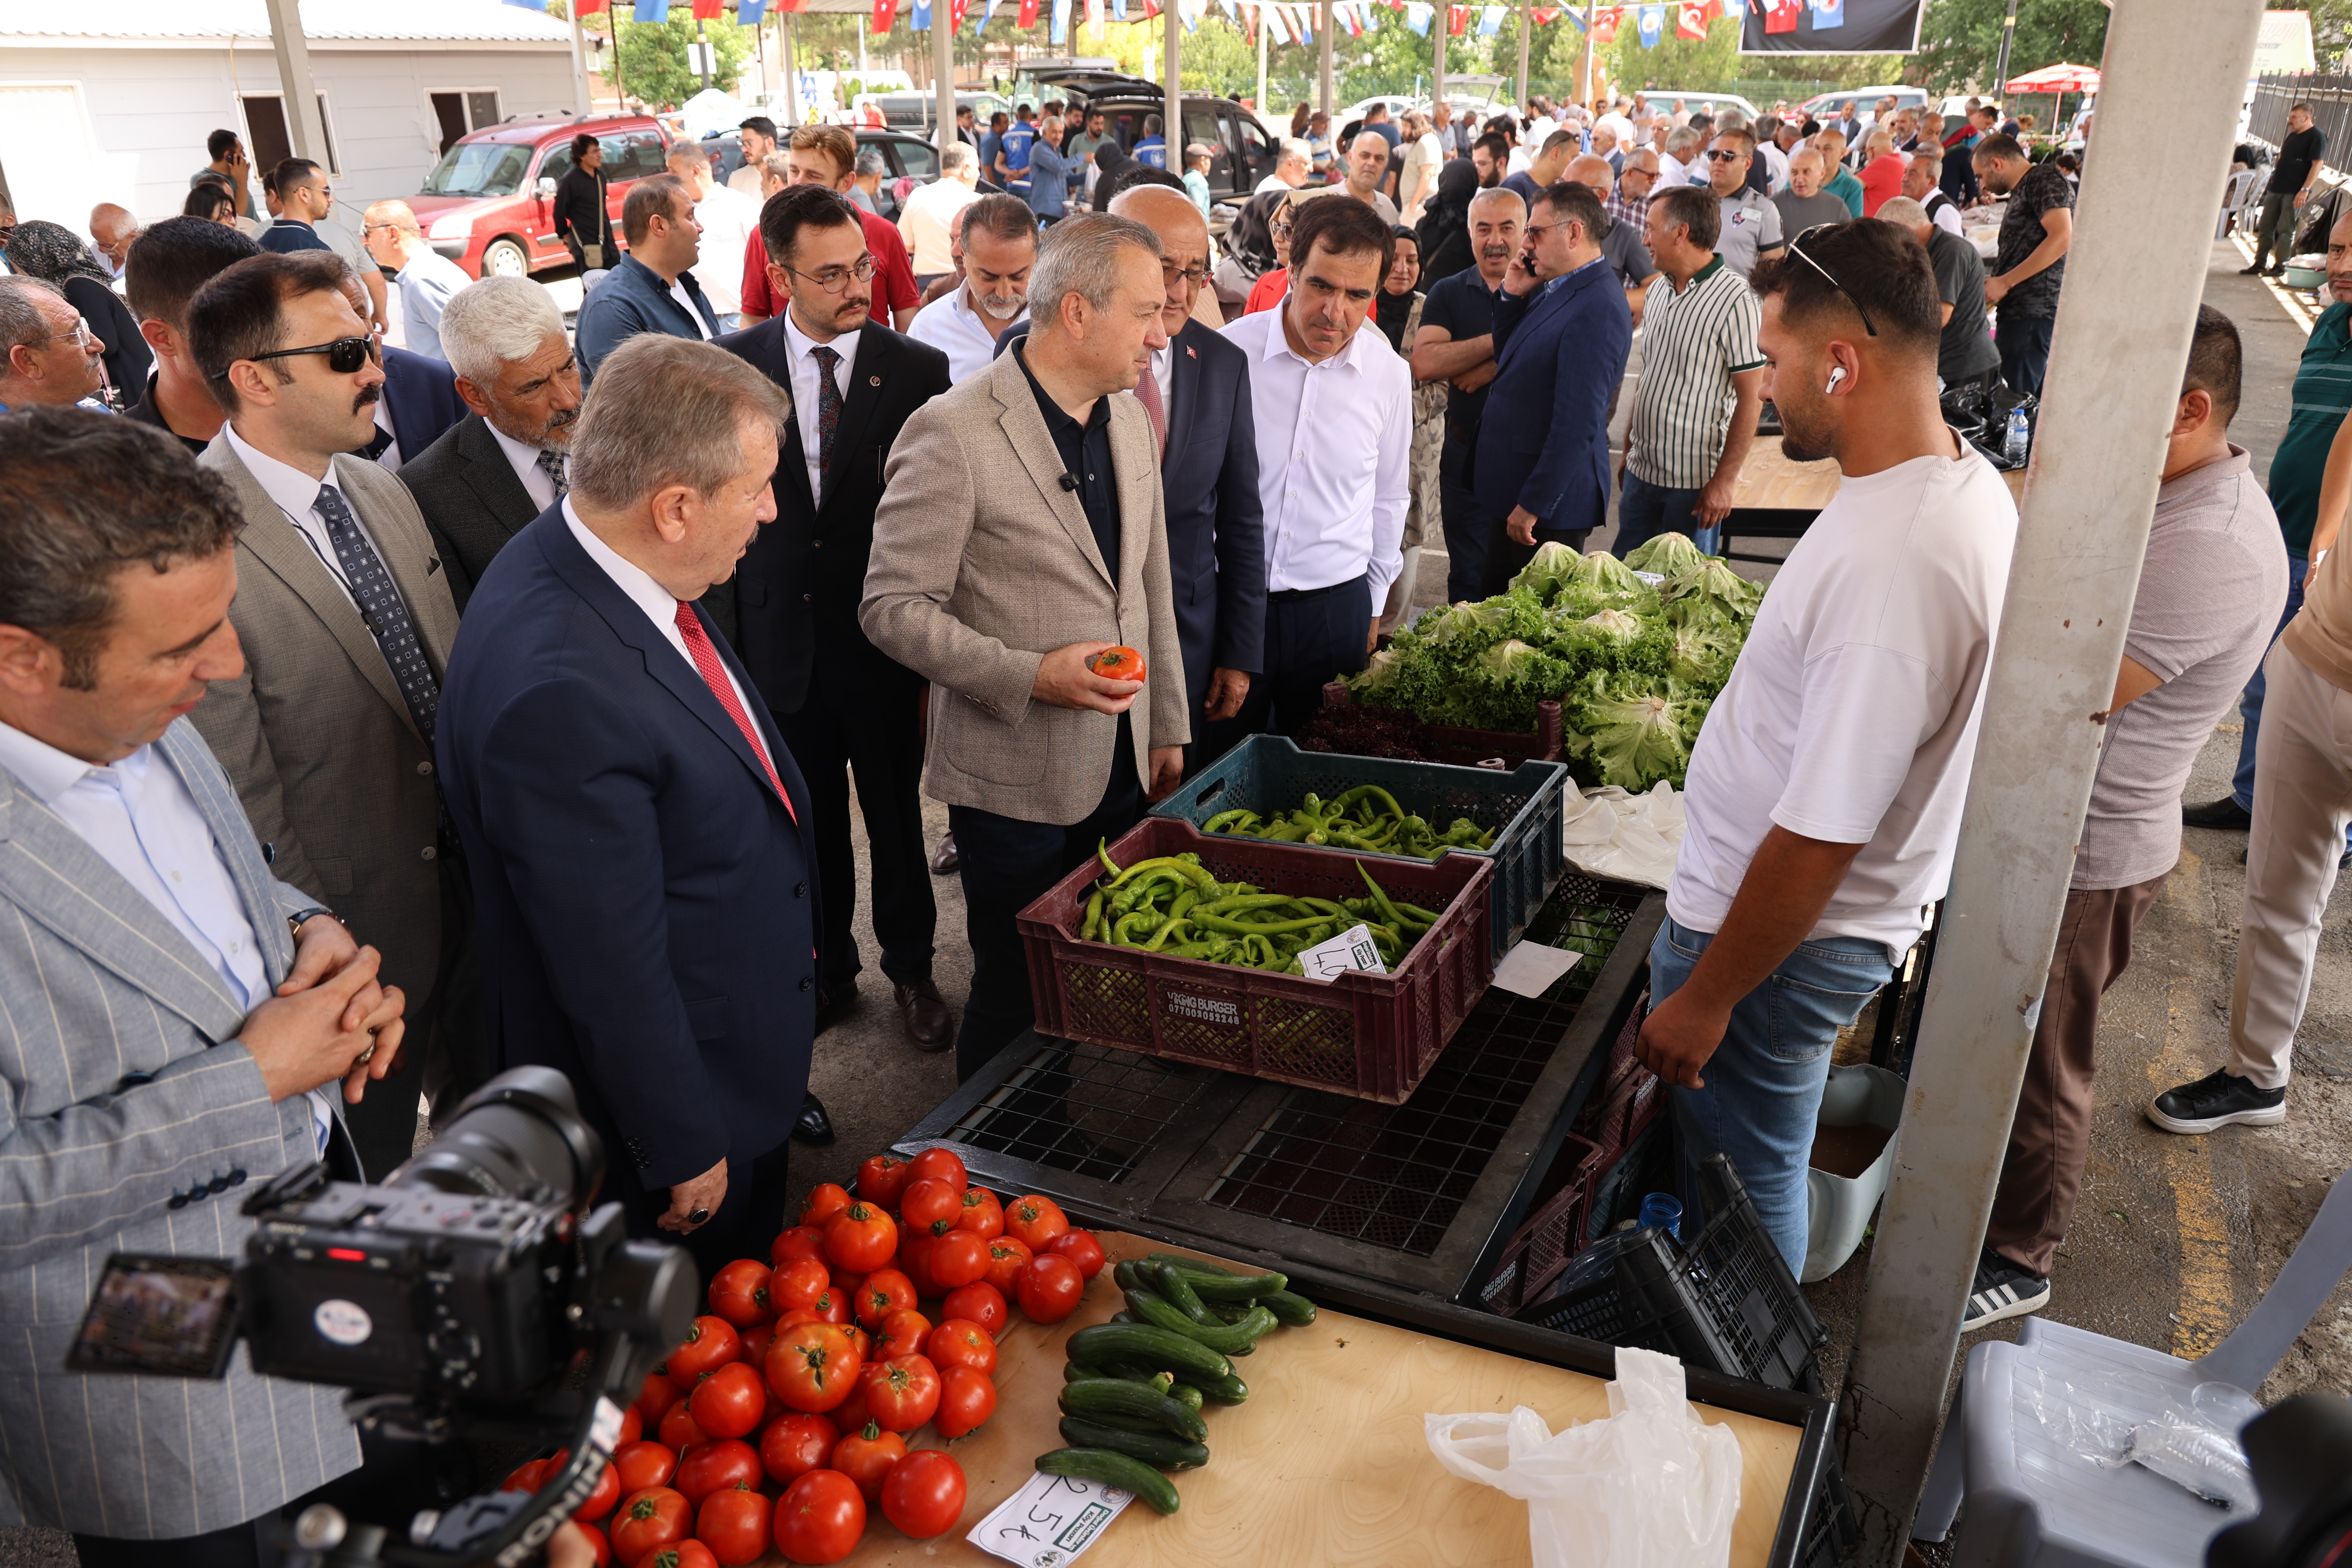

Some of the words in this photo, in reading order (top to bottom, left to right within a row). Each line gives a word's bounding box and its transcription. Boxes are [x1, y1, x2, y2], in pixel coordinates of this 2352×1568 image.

[1082, 1510, 1095, 1523] Köy
[1093, 1510, 1110, 1526] Doğal
[1076, 1523, 1096, 1544] Ürünler
